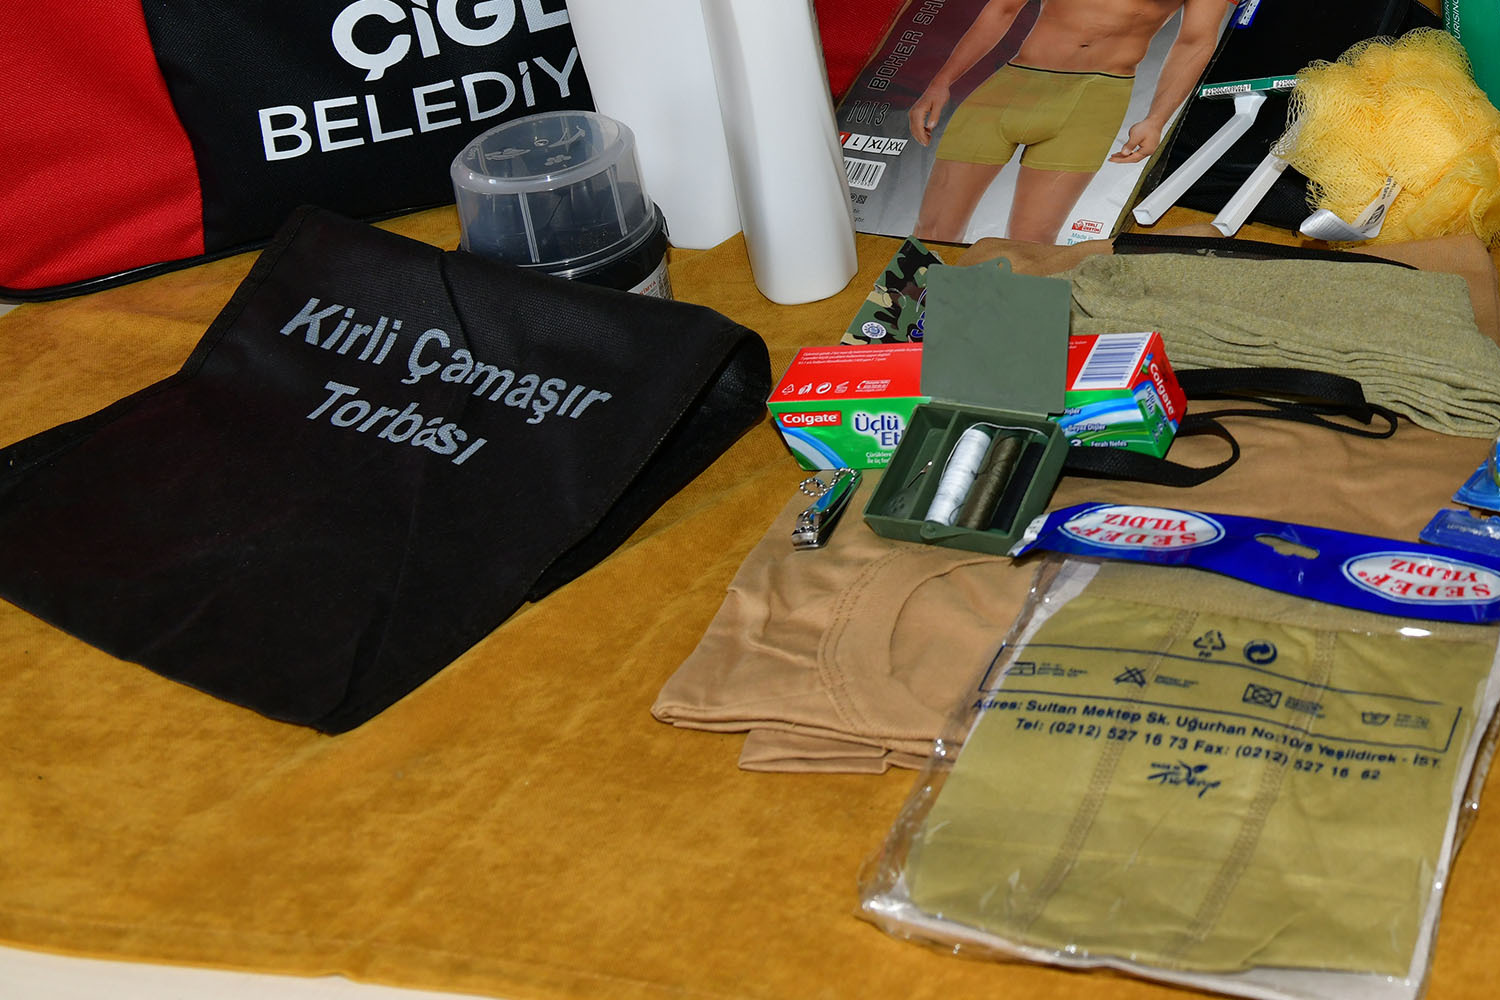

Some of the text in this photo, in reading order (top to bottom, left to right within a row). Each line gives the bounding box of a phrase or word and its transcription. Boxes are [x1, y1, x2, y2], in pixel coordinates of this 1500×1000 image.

[258, 46, 579, 162] BELEDİY
[847, 100, 891, 126] 1013
[852, 137, 859, 146] L
[868, 139, 884, 150] XL
[886, 141, 904, 152] XXL
[280, 297, 613, 425] Kirli Çamaşır
[1150, 363, 1175, 415] Colgate
[306, 380, 488, 466] Torbası
[783, 413, 838, 425] Colgate
[855, 413, 899, 434] Üçlü
[881, 430, 904, 446] Et
[1103, 513, 1188, 533] YILDIZ
[1077, 528, 1197, 548] SEDEF
[1388, 558, 1478, 584] YILDIZ
[1365, 570, 1491, 599] SEDEF
[972, 699, 1023, 712] Adres:
[1026, 700, 1077, 716] Sultan
[1082, 705, 1141, 724] Mektep
[1145, 712, 1170, 726] Sk.
[1176, 716, 1246, 736] Uğurhan
[1318, 743, 1396, 764] Yeşildirek
[1016, 717, 1044, 731] Tel:
[1049, 721, 1101, 739] (0212)
[1107, 729, 1137, 742] 527
[1144, 733, 1163, 746] 16
[1169, 736, 1188, 750] 73
[1194, 741, 1228, 756] Fax:
[1236, 745, 1288, 766] (0212)
[1294, 759, 1324, 773] 527
